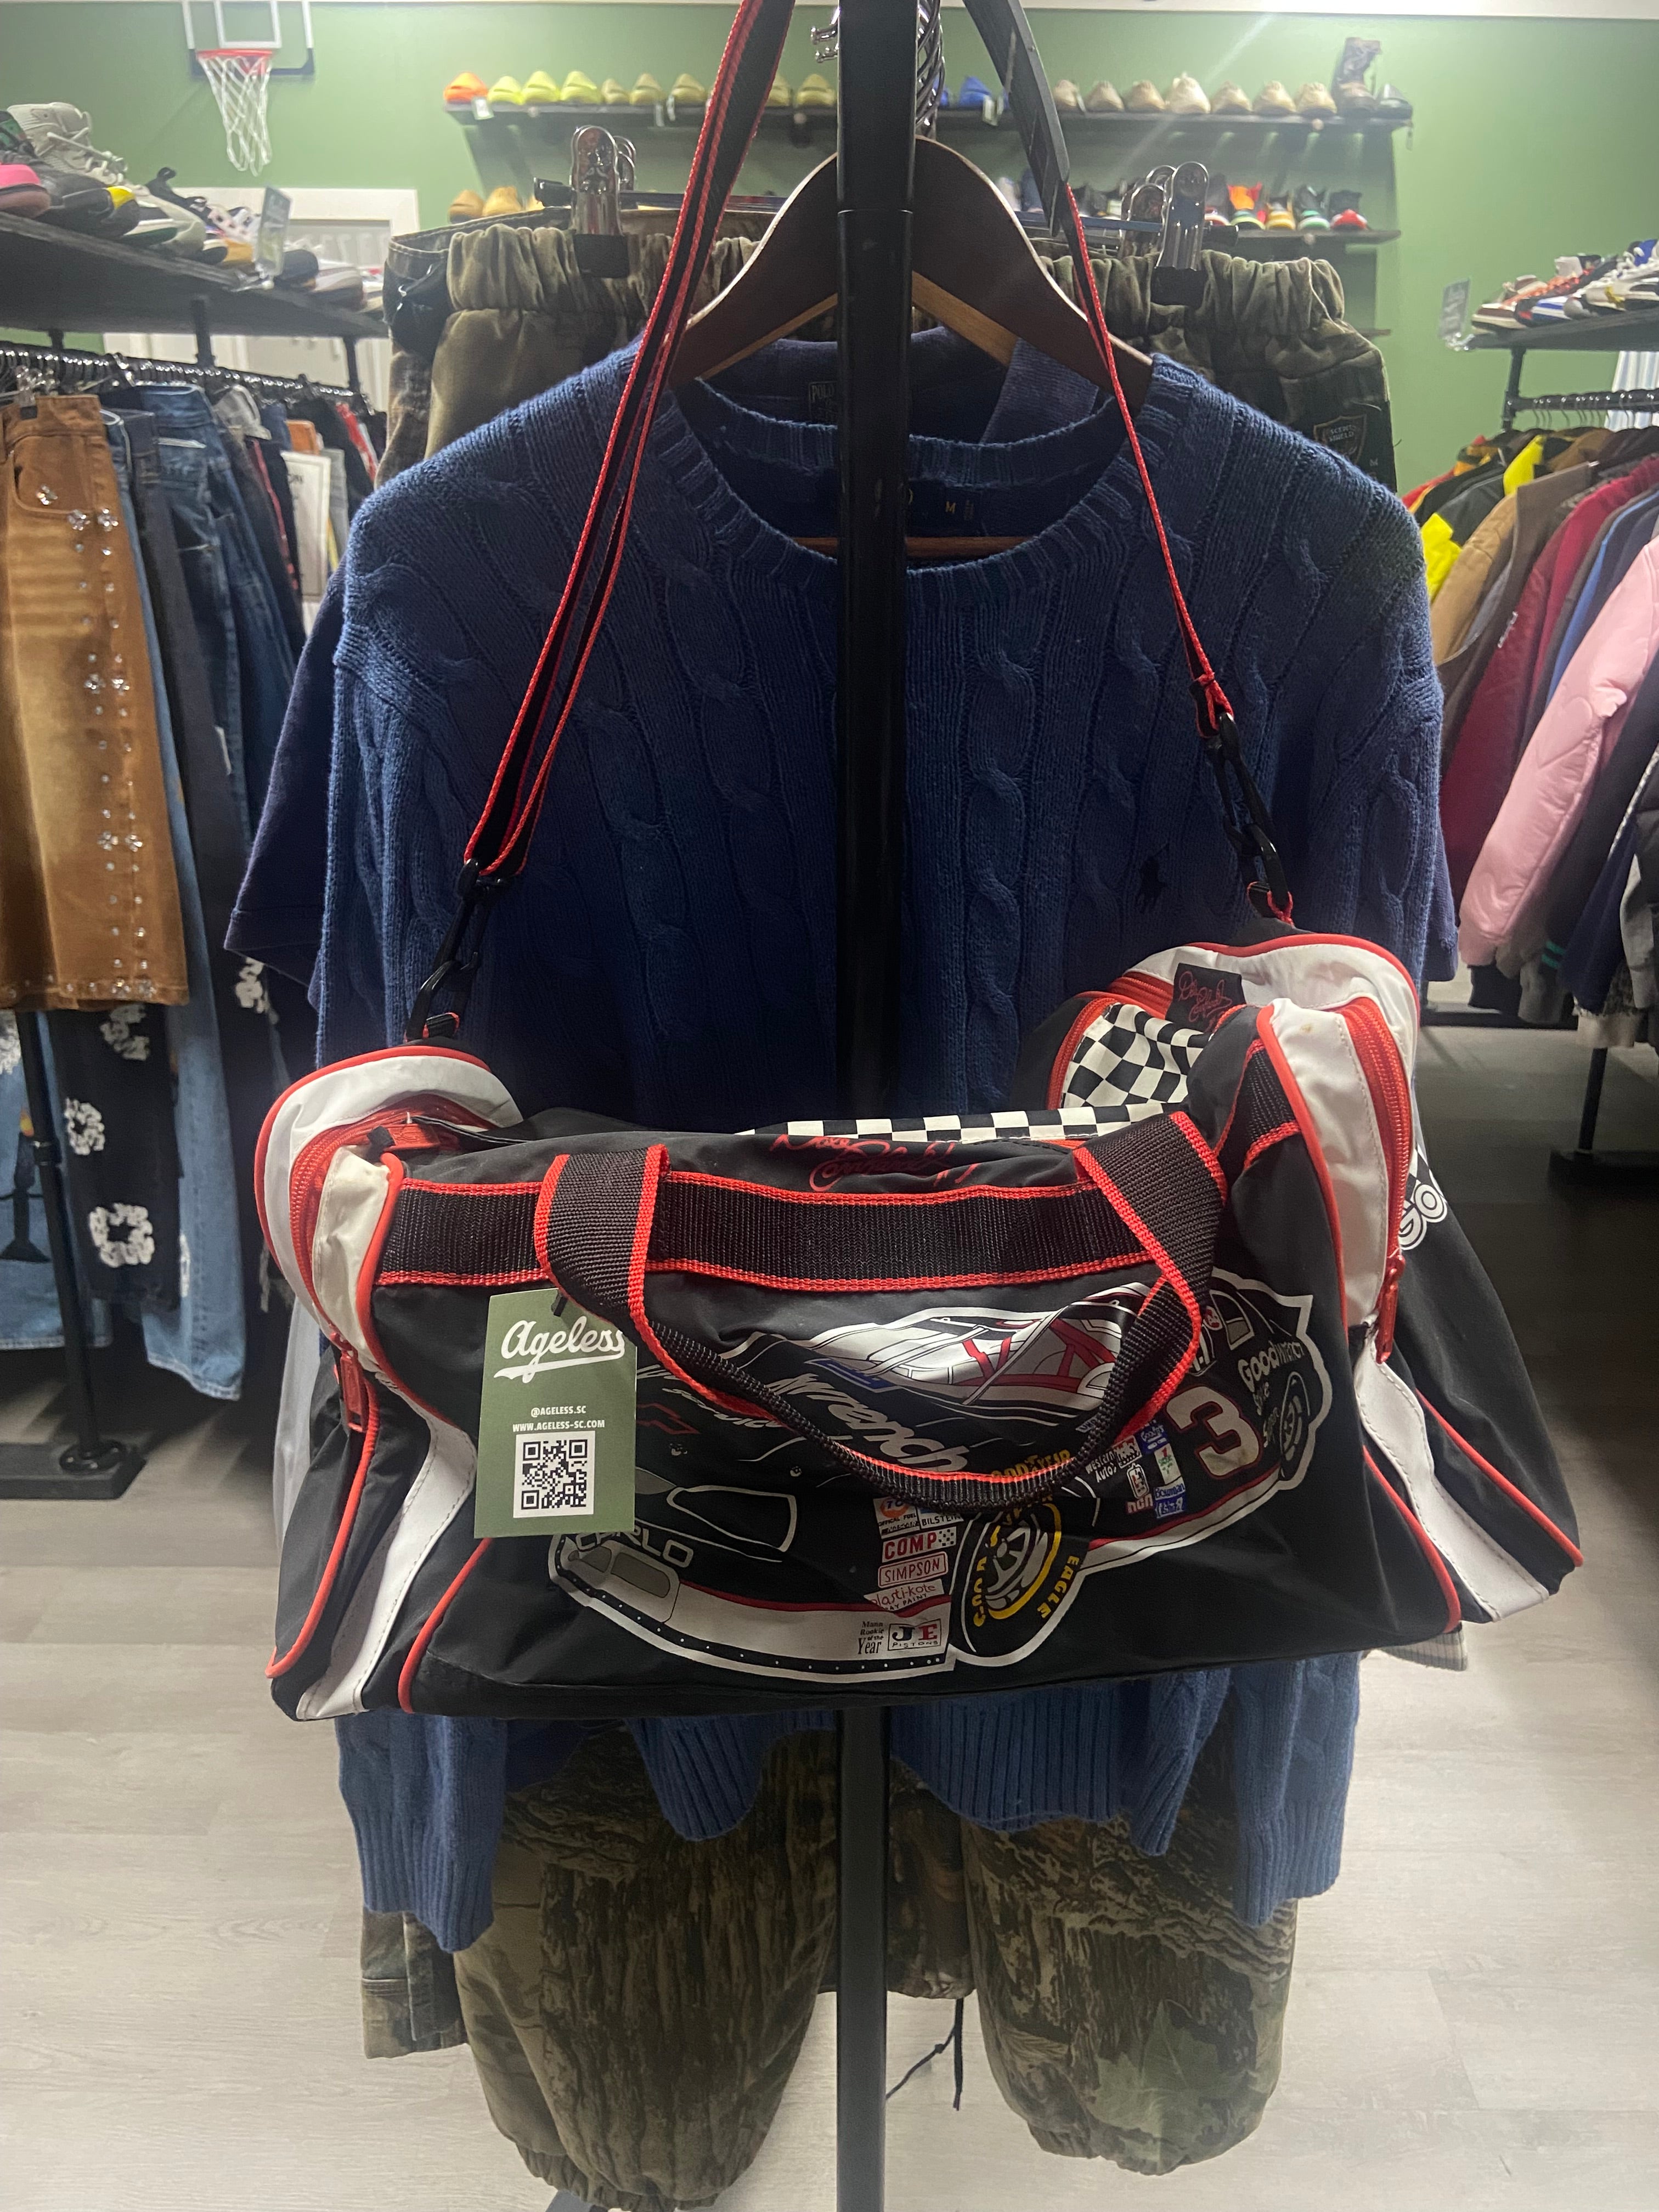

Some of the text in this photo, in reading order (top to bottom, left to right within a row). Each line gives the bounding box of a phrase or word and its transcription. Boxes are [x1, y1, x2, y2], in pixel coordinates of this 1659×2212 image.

[945, 500, 956, 514] M
[496, 1316, 625, 1383] Ageless
[531, 1405, 586, 1418] @AGELESS.SC
[512, 1419, 605, 1432] WWW.AGELESS-SC.COM
[1166, 1385, 1260, 1477] 3
[884, 1532, 937, 1560] COMP
[884, 1558, 940, 1583] SIMPSON
[1037, 1555, 1080, 1618] EAGLE
[858, 1637, 882, 1655] Year
[892, 1640, 939, 1649] PISTONS
